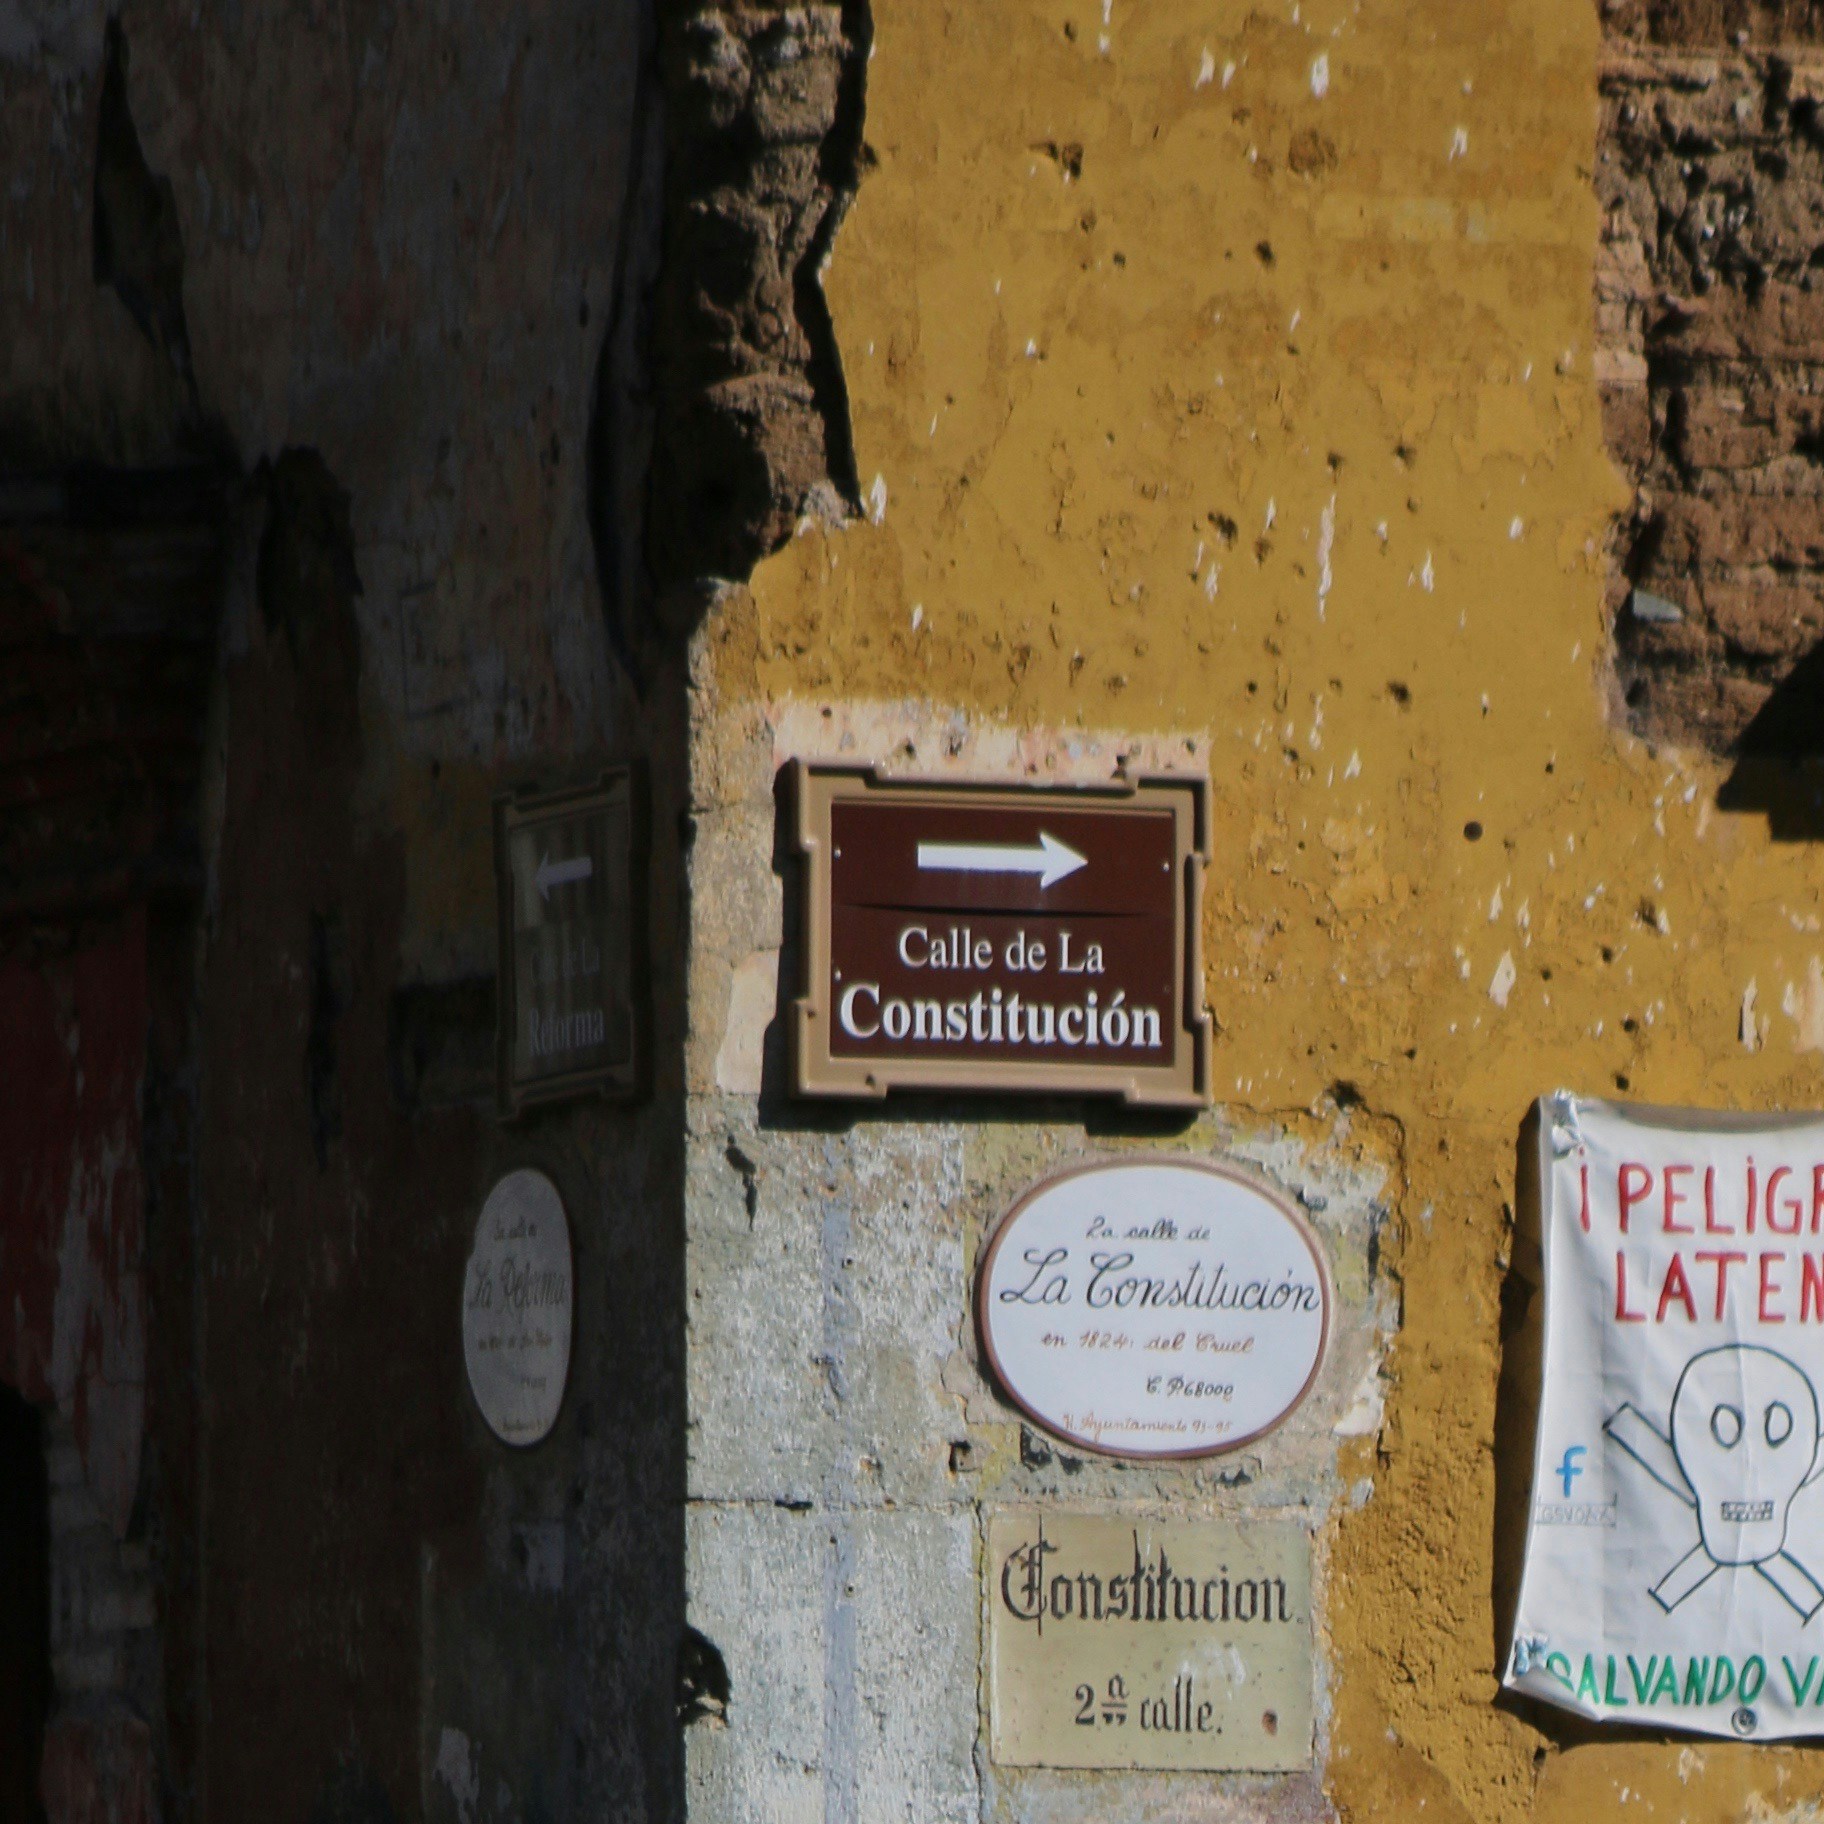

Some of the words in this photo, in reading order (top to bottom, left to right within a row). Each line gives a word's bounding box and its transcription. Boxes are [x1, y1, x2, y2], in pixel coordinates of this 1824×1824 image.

[900, 926, 993, 970] Calle
[1006, 930, 1046, 972] de
[1059, 932, 1104, 974] La
[840, 982, 1162, 1048] Constitución
[1123, 1217, 1178, 1241] calle
[1186, 1225, 1211, 1241] de
[999, 1248, 1072, 1306] La
[1086, 1251, 1320, 1311] Constitución
[1041, 1331, 1067, 1347] en
[1144, 1331, 1187, 1351] del
[1546, 1654, 1765, 1707] SALVANDO
